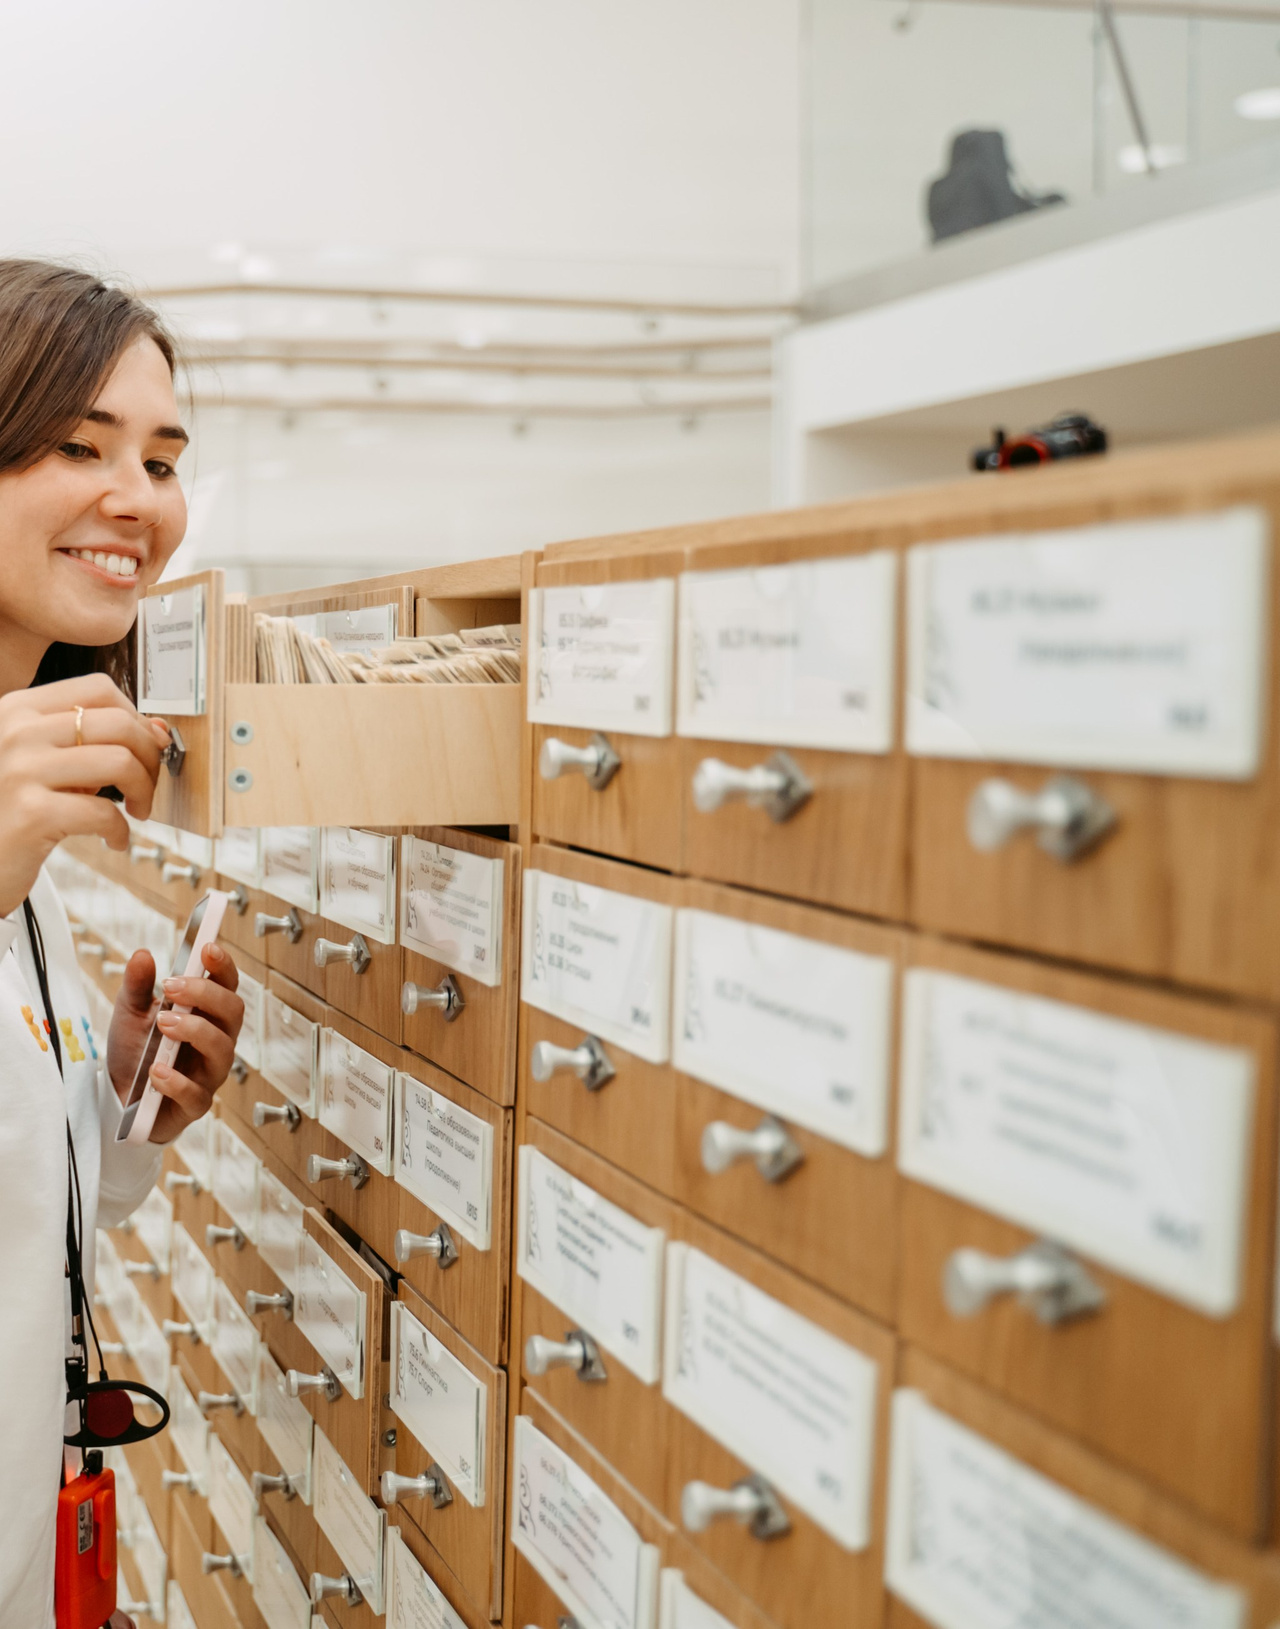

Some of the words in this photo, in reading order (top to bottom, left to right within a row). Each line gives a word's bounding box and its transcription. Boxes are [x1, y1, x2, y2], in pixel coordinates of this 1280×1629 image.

[425, 1140, 442, 1158] школы
[426, 1118, 454, 1149] Педагогика
[454, 1140, 476, 1162] высшей
[446, 1114, 480, 1146] образование
[424, 1155, 461, 1195] (продолжение)
[466, 1201, 478, 1222] 1815
[408, 1341, 419, 1362] 75.6
[418, 1349, 449, 1395] Гимнастика
[408, 1360, 418, 1380] 75.7
[417, 1371, 434, 1398] Спорт
